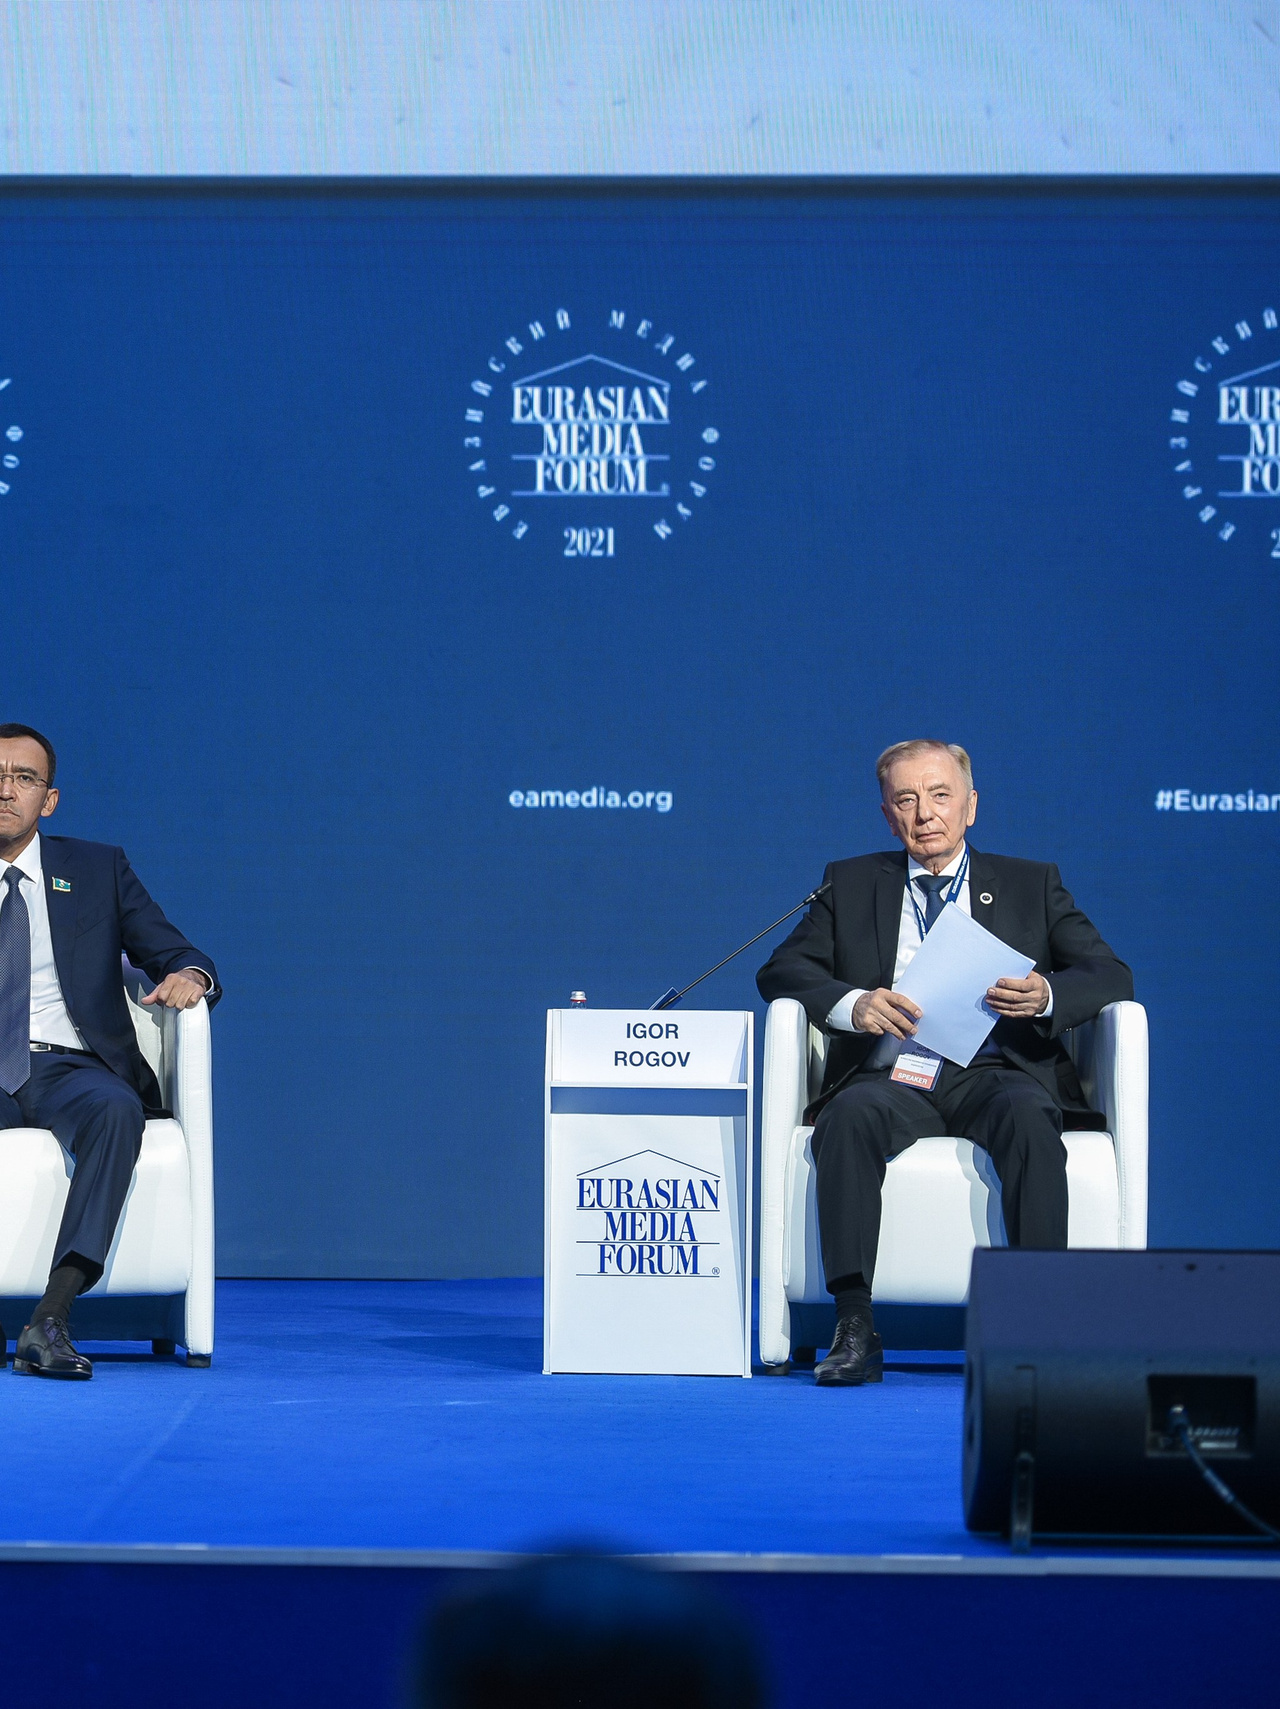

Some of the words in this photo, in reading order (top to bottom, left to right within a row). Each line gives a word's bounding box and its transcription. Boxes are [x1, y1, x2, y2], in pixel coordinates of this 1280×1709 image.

[513, 386, 669, 423] EURASIAN
[542, 422, 644, 458] MEDIA
[535, 458, 647, 494] FORUM
[563, 527, 615, 557] 2021
[509, 786, 673, 812] eamedia.org
[626, 1022, 679, 1040] IGOR
[614, 1051, 690, 1068] ROGOV
[898, 1073, 928, 1085] SPEAKER
[576, 1178, 720, 1209] EURASIAN
[604, 1211, 698, 1241] MEDIA
[597, 1244, 700, 1275] FORUM
